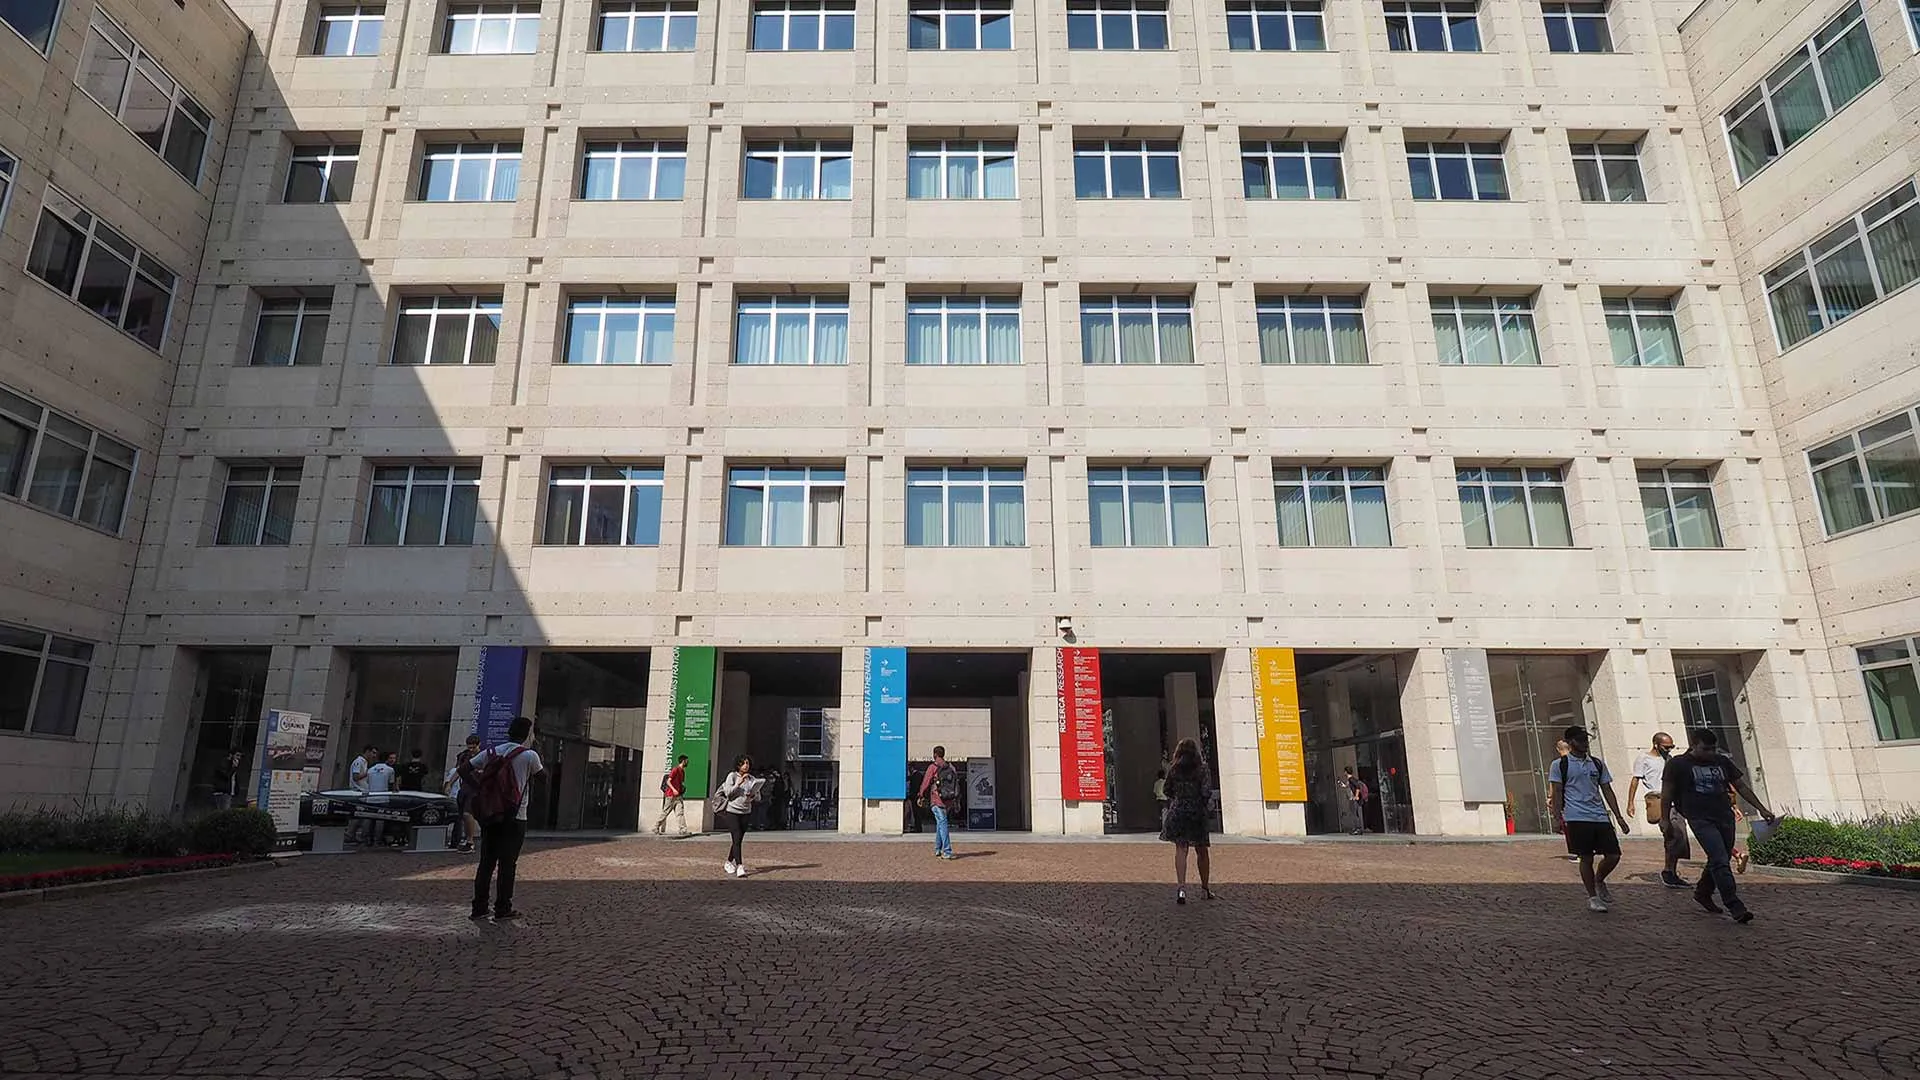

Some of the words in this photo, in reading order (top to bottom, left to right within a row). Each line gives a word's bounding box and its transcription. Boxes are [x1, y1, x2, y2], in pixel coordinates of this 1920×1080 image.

[471, 698, 481, 734] IMPRESE
[477, 646, 487, 692] COMPANIES
[669, 646, 680, 712] ADMINISTRATION
[864, 647, 872, 694] ATHENAEUM
[1252, 648, 1261, 689] DIDACTICS
[1444, 648, 1456, 689] SERVICES
[1256, 696, 1265, 738] DIDATTICA
[1451, 694, 1461, 726] SERVIZI
[664, 718, 675, 774] INISTRAZIONE
